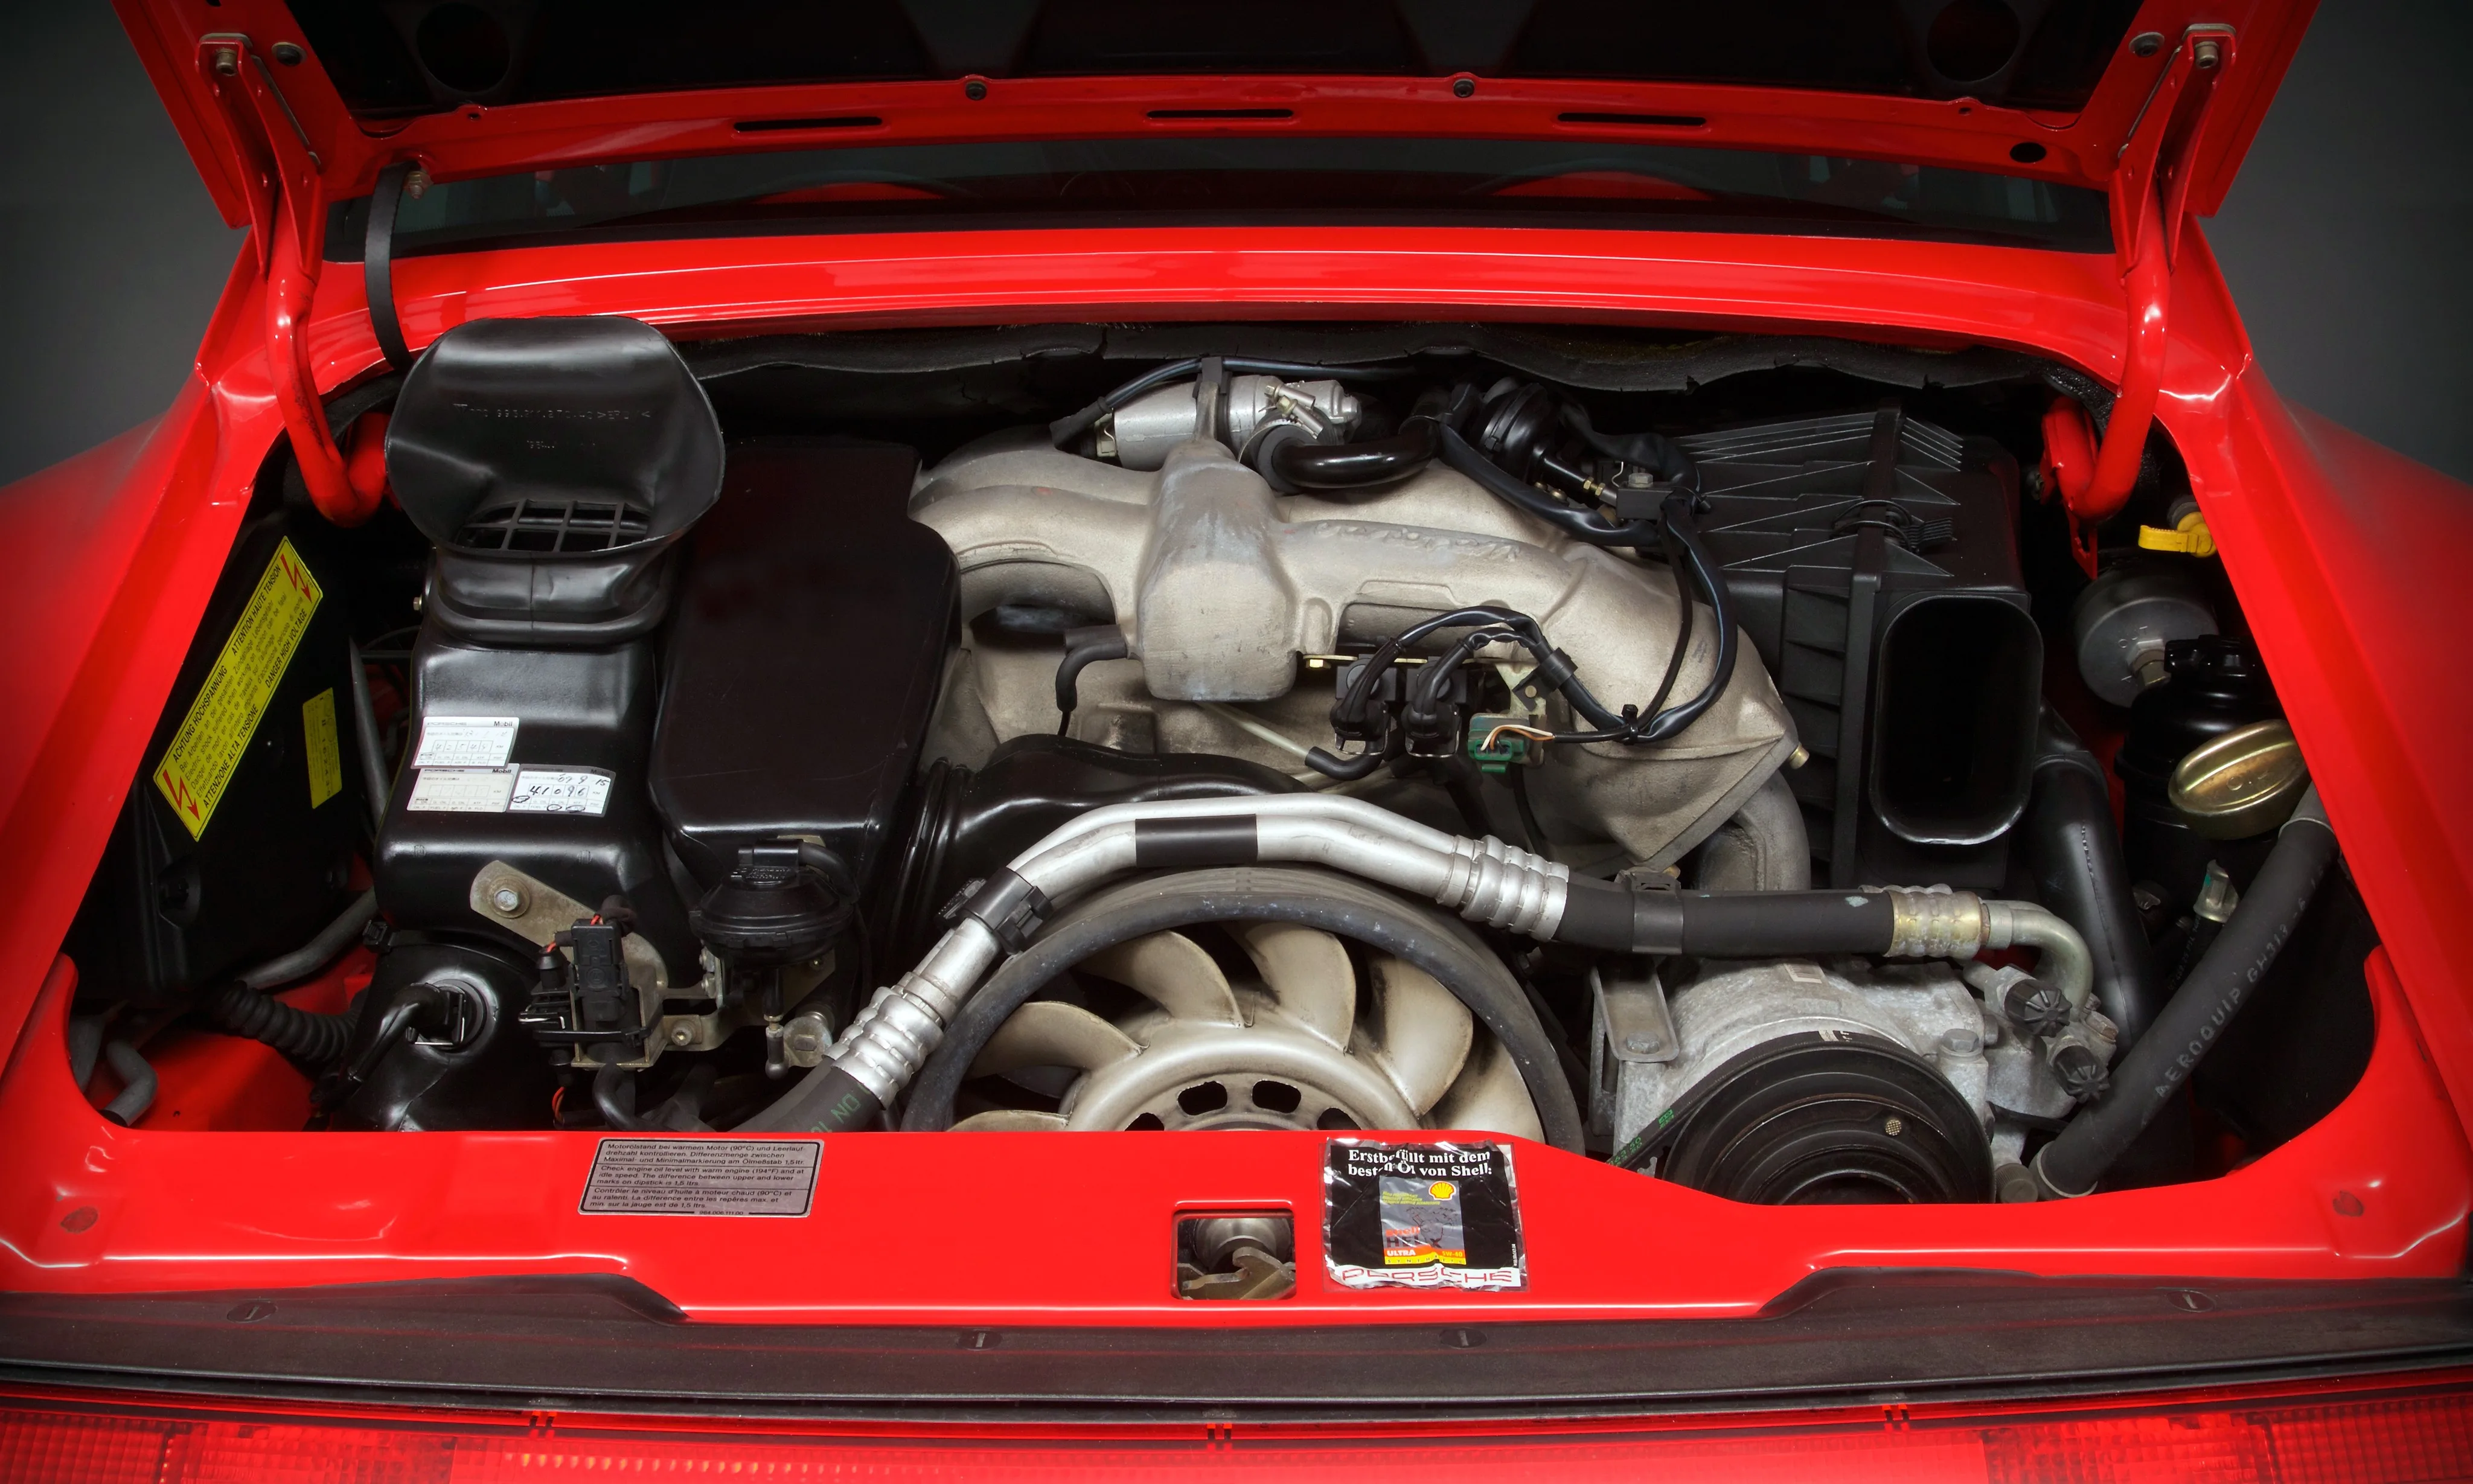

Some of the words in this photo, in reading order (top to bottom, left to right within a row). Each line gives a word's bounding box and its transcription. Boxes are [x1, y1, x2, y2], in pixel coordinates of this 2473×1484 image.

[232, 616, 254, 656] ATTENTION
[252, 595, 266, 620] HAUTE
[263, 564, 281, 598] TENSION
[265, 657, 282, 689] DANGER
[280, 639, 291, 659] HIGH
[290, 608, 307, 642] VOLTAGE
[173, 724, 196, 763] ACHTUNG
[193, 665, 227, 726] HOCHSPANNUNG
[179, 760, 189, 773] Bei
[188, 731, 205, 759] Arbeiten
[204, 720, 210, 729] an
[217, 675, 234, 706] gesamten
[185, 755, 201, 781] Electric
[200, 736, 213, 755] shock
[213, 708, 227, 734] suffered
[227, 688, 237, 705] when
[237, 663, 251, 688] working
[250, 653, 256, 663] on
[273, 607, 279, 617] be
[191, 765, 206, 790] Danger
[206, 753, 212, 764] de
[212, 737, 222, 752] mort
[222, 726, 227, 735] en
[234, 700, 240, 711] de
[196, 761, 218, 799] Effettuando
[203, 760, 230, 808] ATTENZIONE
[228, 741, 240, 762] ALTA
[237, 703, 258, 741] TENSIONE
[2154, 987, 2241, 1099] AEROQUIP
[1429, 1153, 1454, 1163] mit
[1459, 1151, 1490, 1163] dem
[1451, 1163, 1492, 1176] Shell:
[1342, 1268, 1512, 1282] PORSCHE
